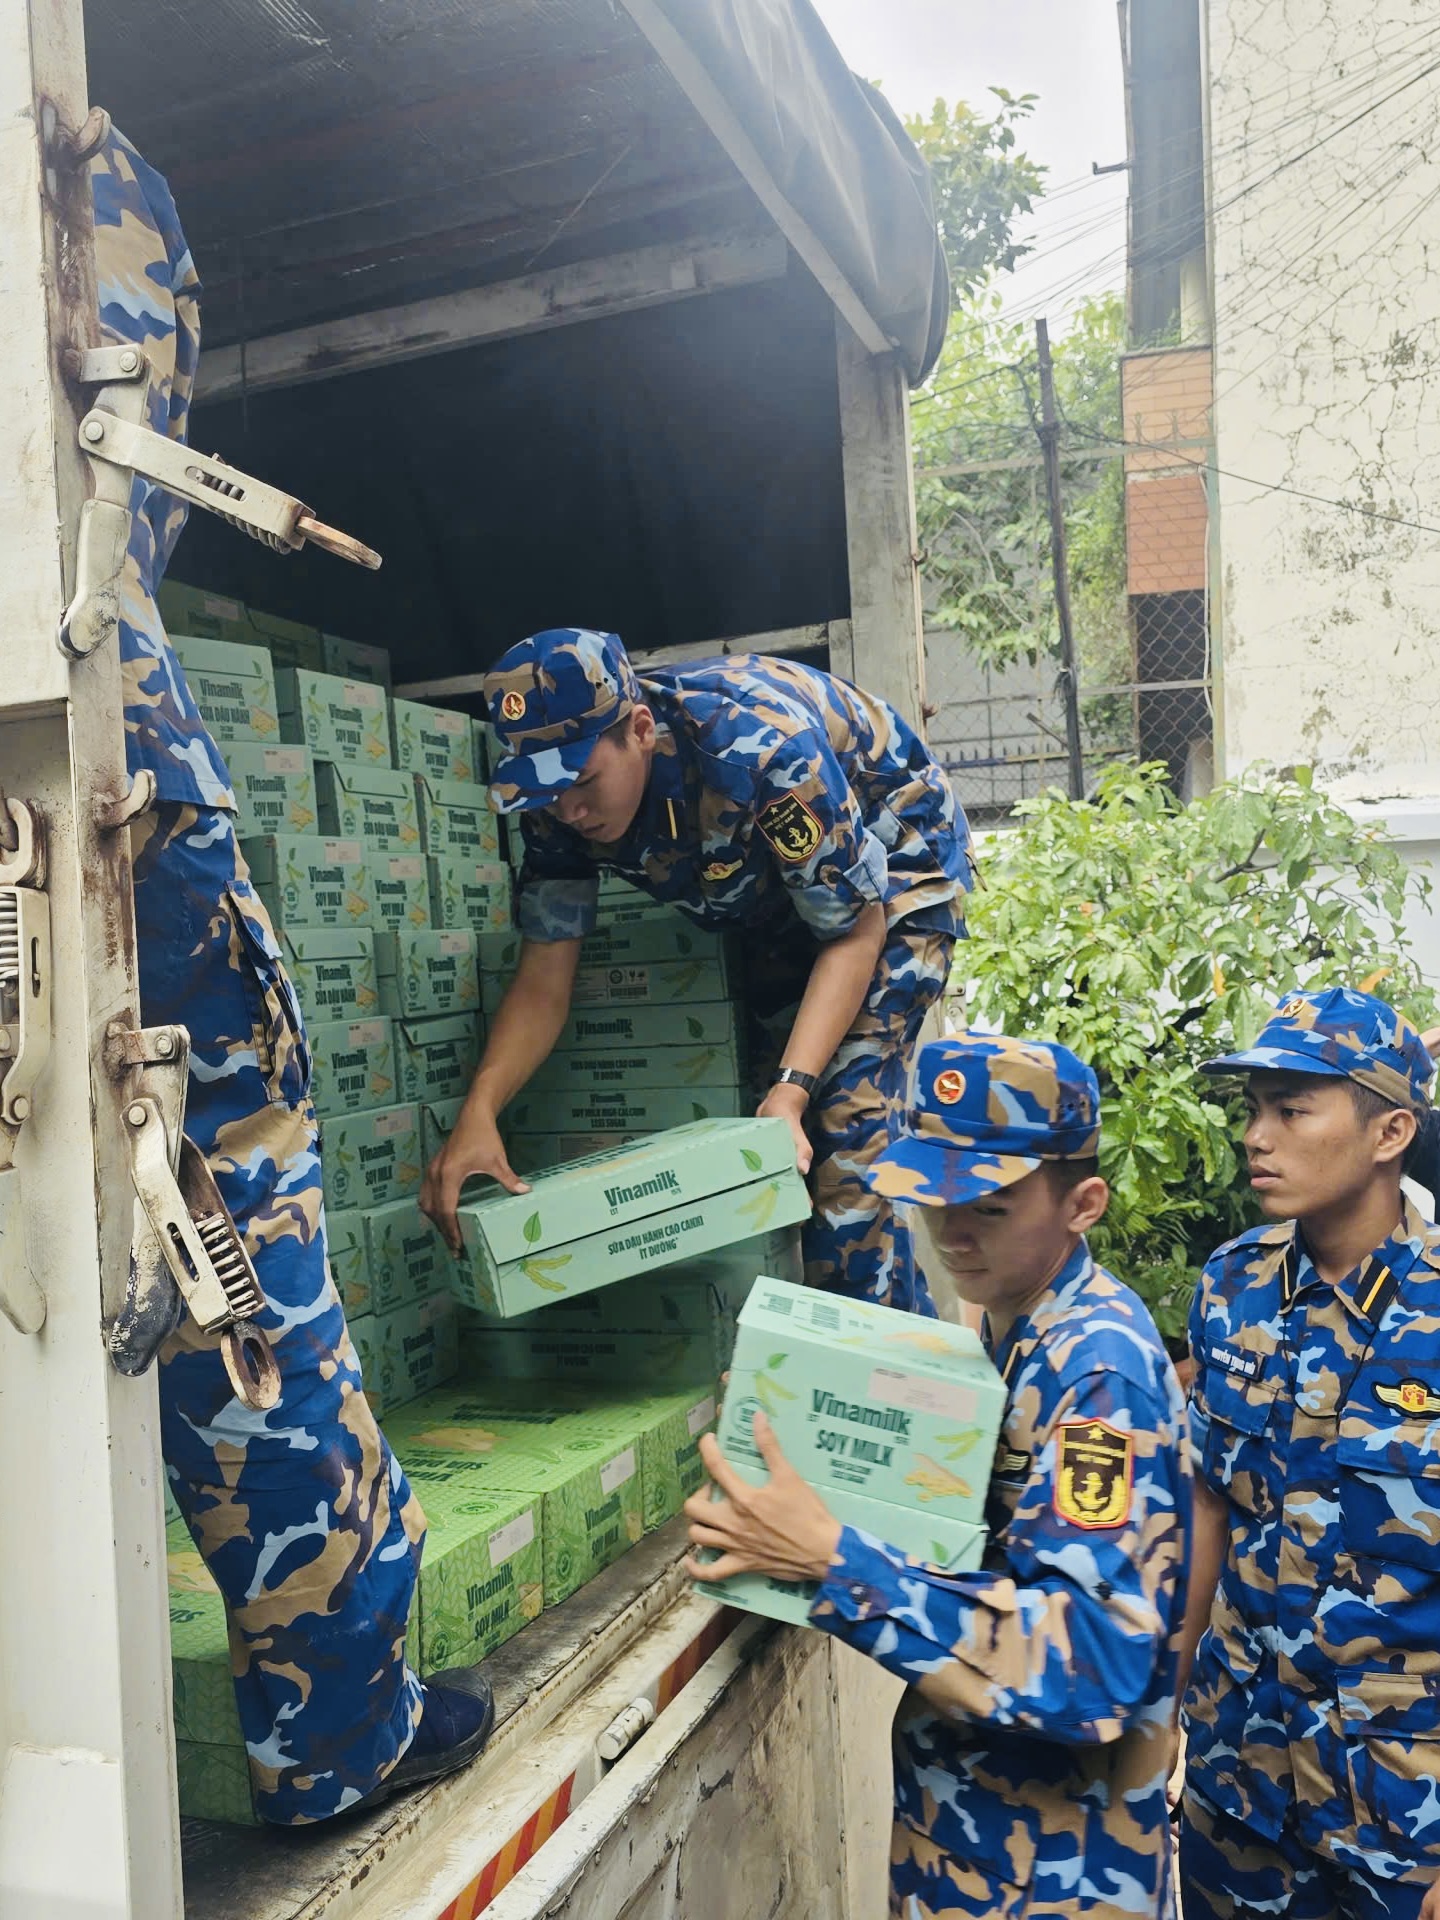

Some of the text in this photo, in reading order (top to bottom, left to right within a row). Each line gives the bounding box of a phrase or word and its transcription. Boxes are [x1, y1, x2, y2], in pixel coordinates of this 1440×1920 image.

[246, 775, 287, 792] Vinamilk
[576, 1018, 633, 1037] Vinamilk
[604, 1170, 679, 1208] Vinamilk
[664, 1222, 680, 1237] CAO
[812, 1388, 911, 1436] Vinamilk
[815, 1429, 894, 1467] SOY MILK
[466, 1562, 514, 1612] Vinamilk
[474, 1600, 510, 1641] SOY MILK
